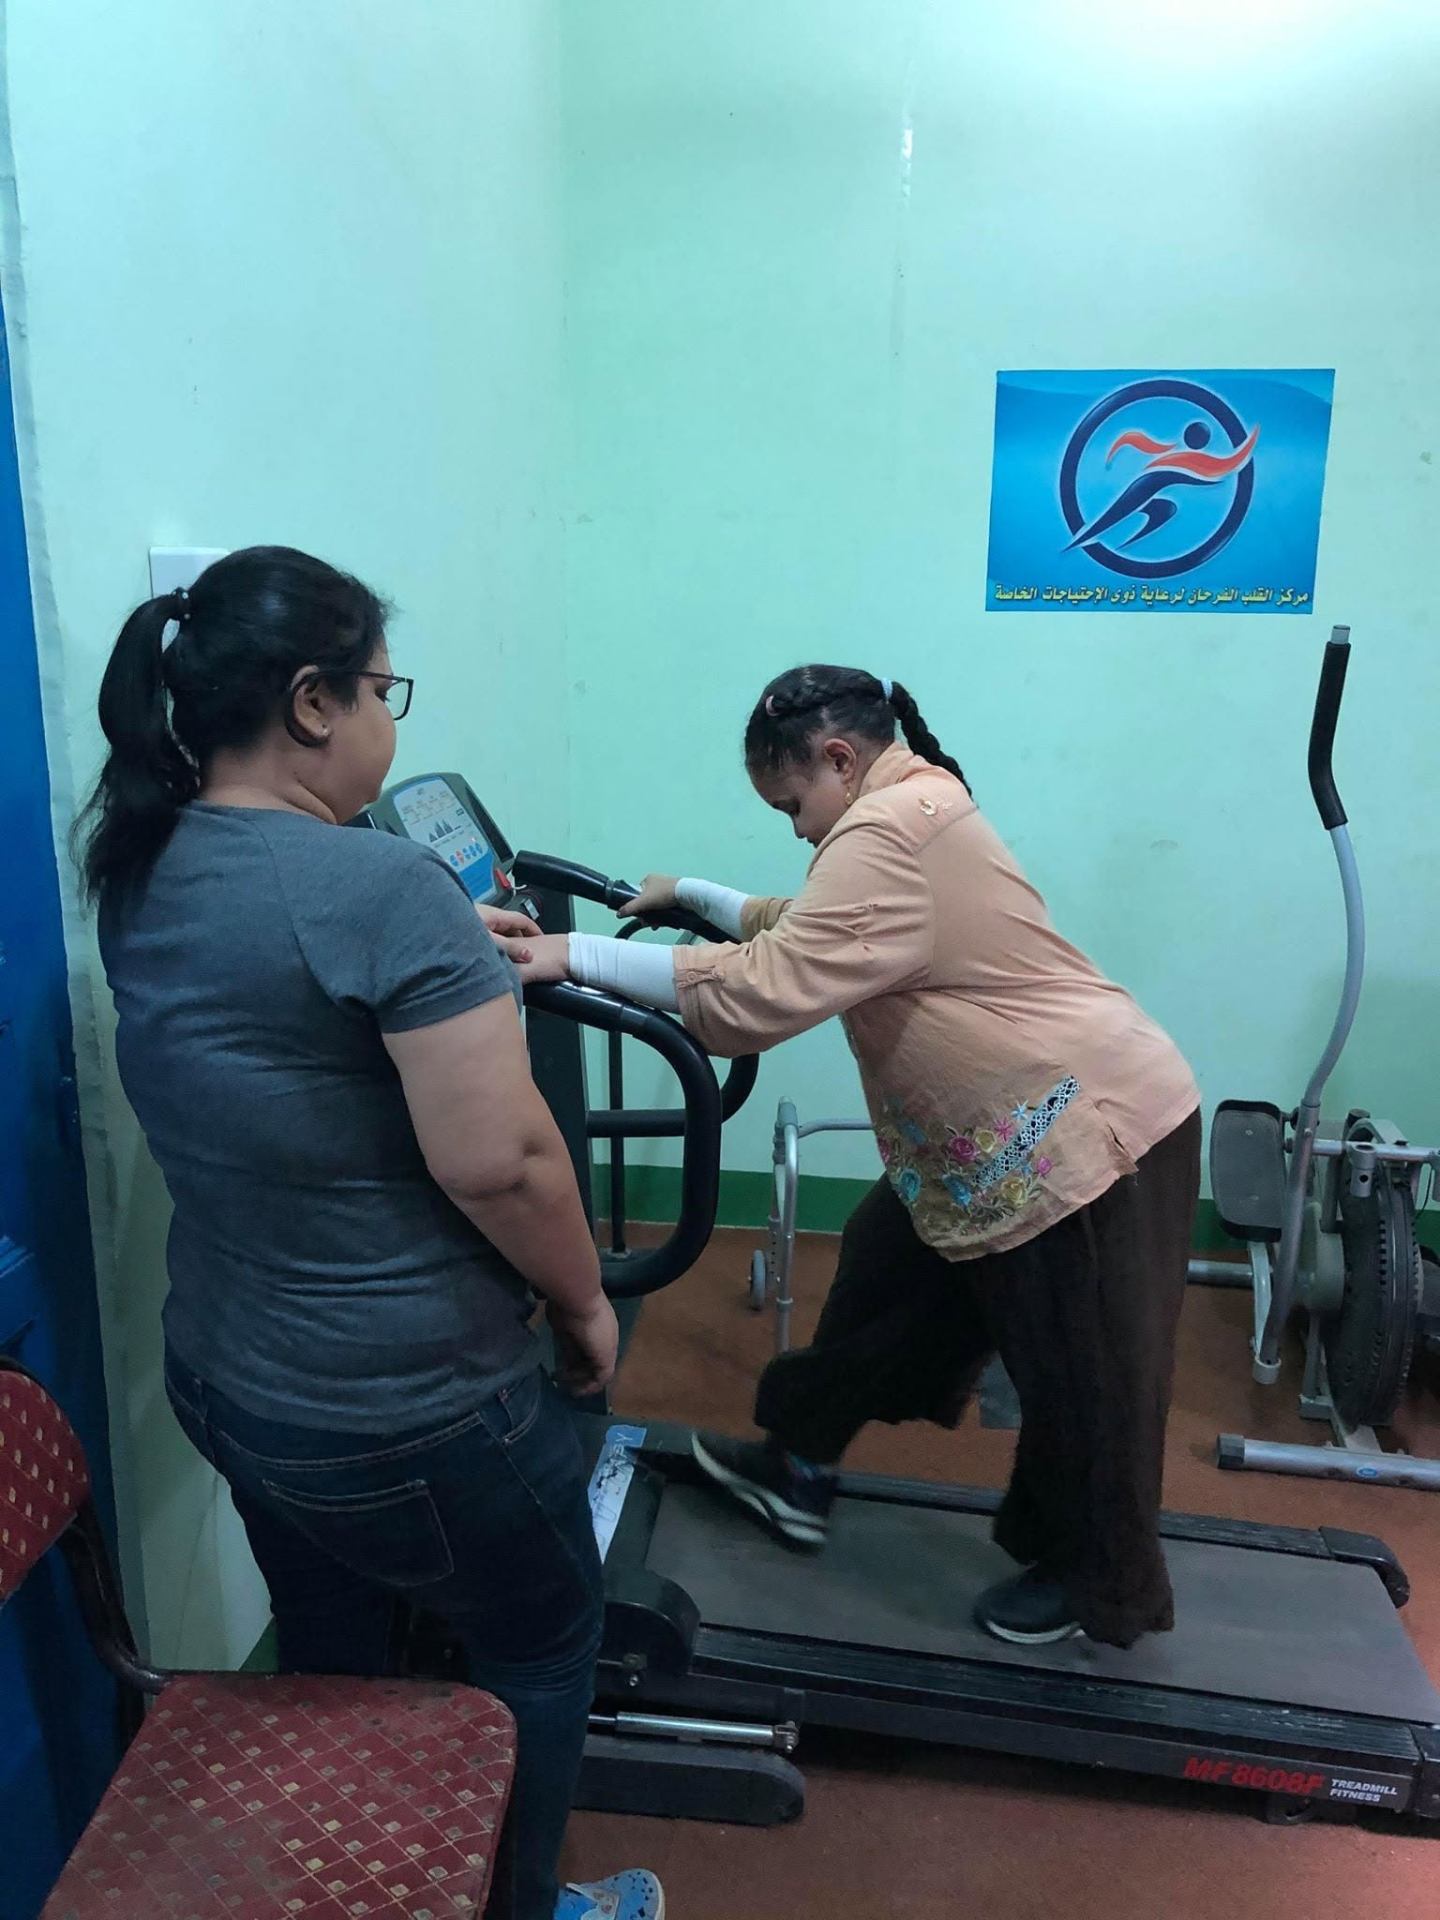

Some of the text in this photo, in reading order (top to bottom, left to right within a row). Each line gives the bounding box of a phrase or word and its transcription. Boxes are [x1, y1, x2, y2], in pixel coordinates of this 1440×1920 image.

[995, 585, 1038, 600] الخاصة
[1140, 585, 1185, 605] لرعاية
[1188, 585, 1238, 605] الفرحان
[1241, 586, 1273, 605] القلب
[1275, 586, 1309, 606] مركز
[1330, 1788, 1381, 1803] FITNESS
[1331, 1778, 1398, 1796] TREADMILL
